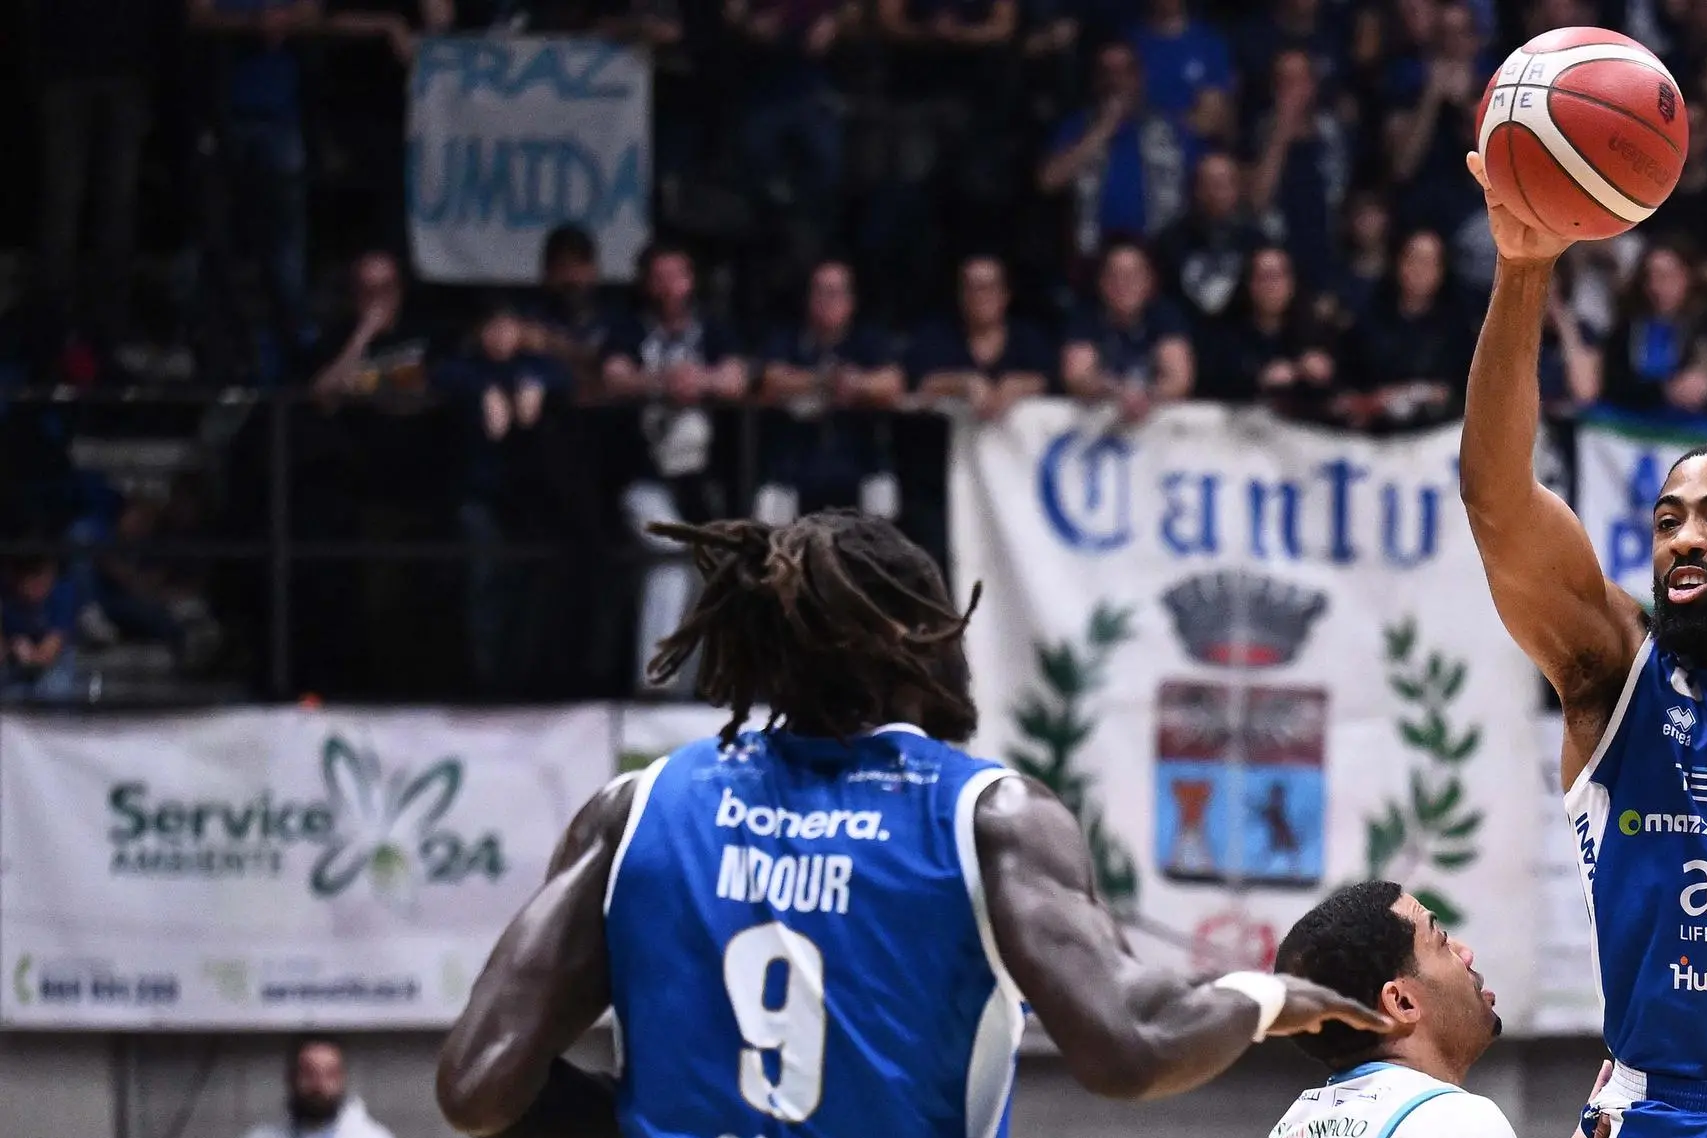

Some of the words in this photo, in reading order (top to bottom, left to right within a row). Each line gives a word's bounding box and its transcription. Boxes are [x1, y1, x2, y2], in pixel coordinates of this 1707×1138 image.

[107, 781, 333, 846] Service
[420, 831, 508, 881] 24
[716, 844, 854, 914] NDOUR
[722, 920, 827, 1123] 9
